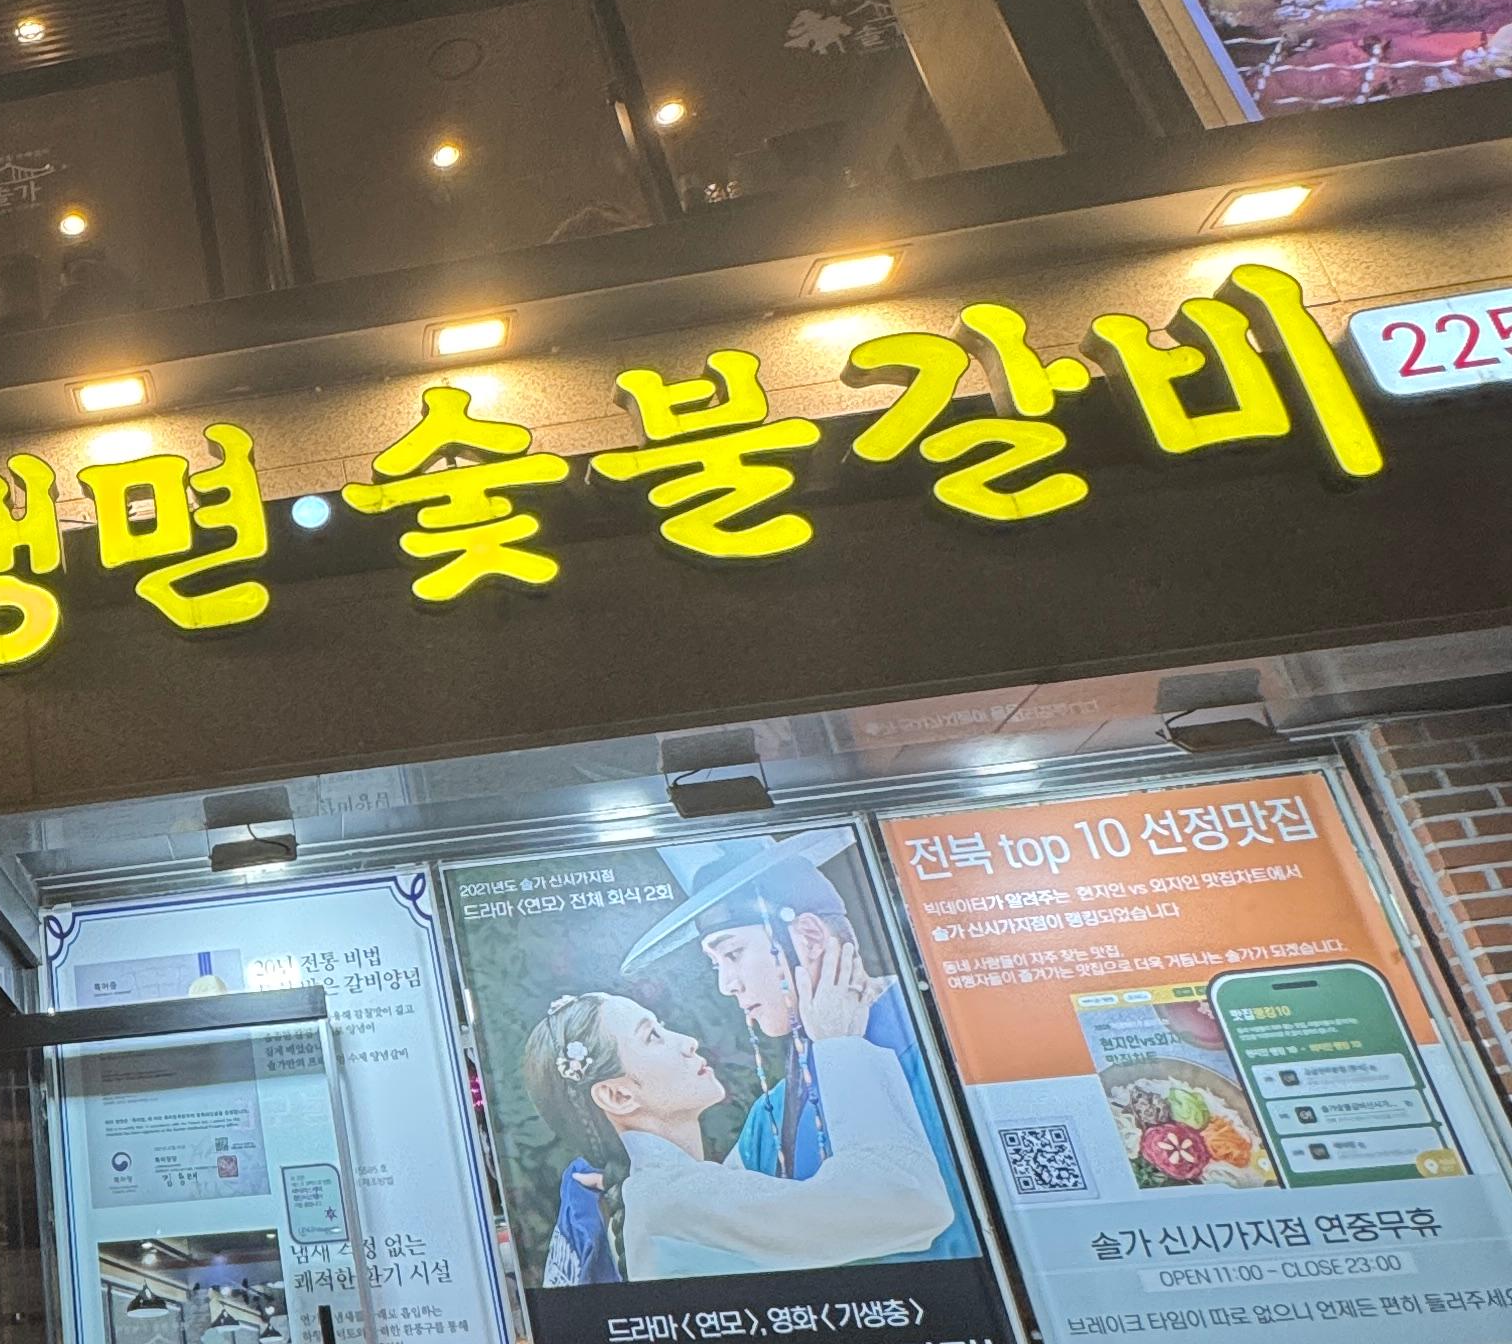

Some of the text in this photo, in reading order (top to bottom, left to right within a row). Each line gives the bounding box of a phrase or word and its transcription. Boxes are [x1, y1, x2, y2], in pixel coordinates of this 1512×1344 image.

[341, 263, 1385, 604] 숯불갈비
[904, 794, 1320, 882] 전북 top 10 선정맛집
[458, 868, 616, 898] 2021년도 솔가 신시가지점
[463, 900, 514, 921] 드라마
[569, 890, 605, 911] 전체
[607, 886, 642, 906] 회식
[644, 882, 675, 903] 2회
[923, 862, 1304, 917] 빅데이터가 알려주는 현지인 vs 외지인 맛집차트에서
[931, 901, 1181, 942] 솔가 신시가지점이 랭킹되었습니다
[301, 945, 382, 974] 전통 비법
[942, 958, 971, 974] 동네
[973, 952, 1028, 971] 사람들이
[1030, 950, 1059, 965] 자주
[1060, 948, 1088, 962] 찾는
[947, 969, 1016, 989] 여행자들이
[1018, 965, 1076, 983] 즐겨가는
[1076, 959, 1134, 977] 맛집으로
[1167, 952, 1224, 970] 거듭나는
[1225, 946, 1269, 964] 솔가가
[343, 965, 422, 994] 갈비양념
[290, 1233, 427, 1265] 냄새 없는
[1091, 1207, 1442, 1261] 솔가 신시가지점 연중무휴
[293, 1259, 453, 1292] 쾌적한 시설
[1159, 1254, 1402, 1288] OPEN 11:00 CLOSE 23:00
[607, 1305, 818, 1343] 드라마 영화
[1067, 1293, 1424, 1335] 브레이크 타임이 따로 없으니 언제든 편히
